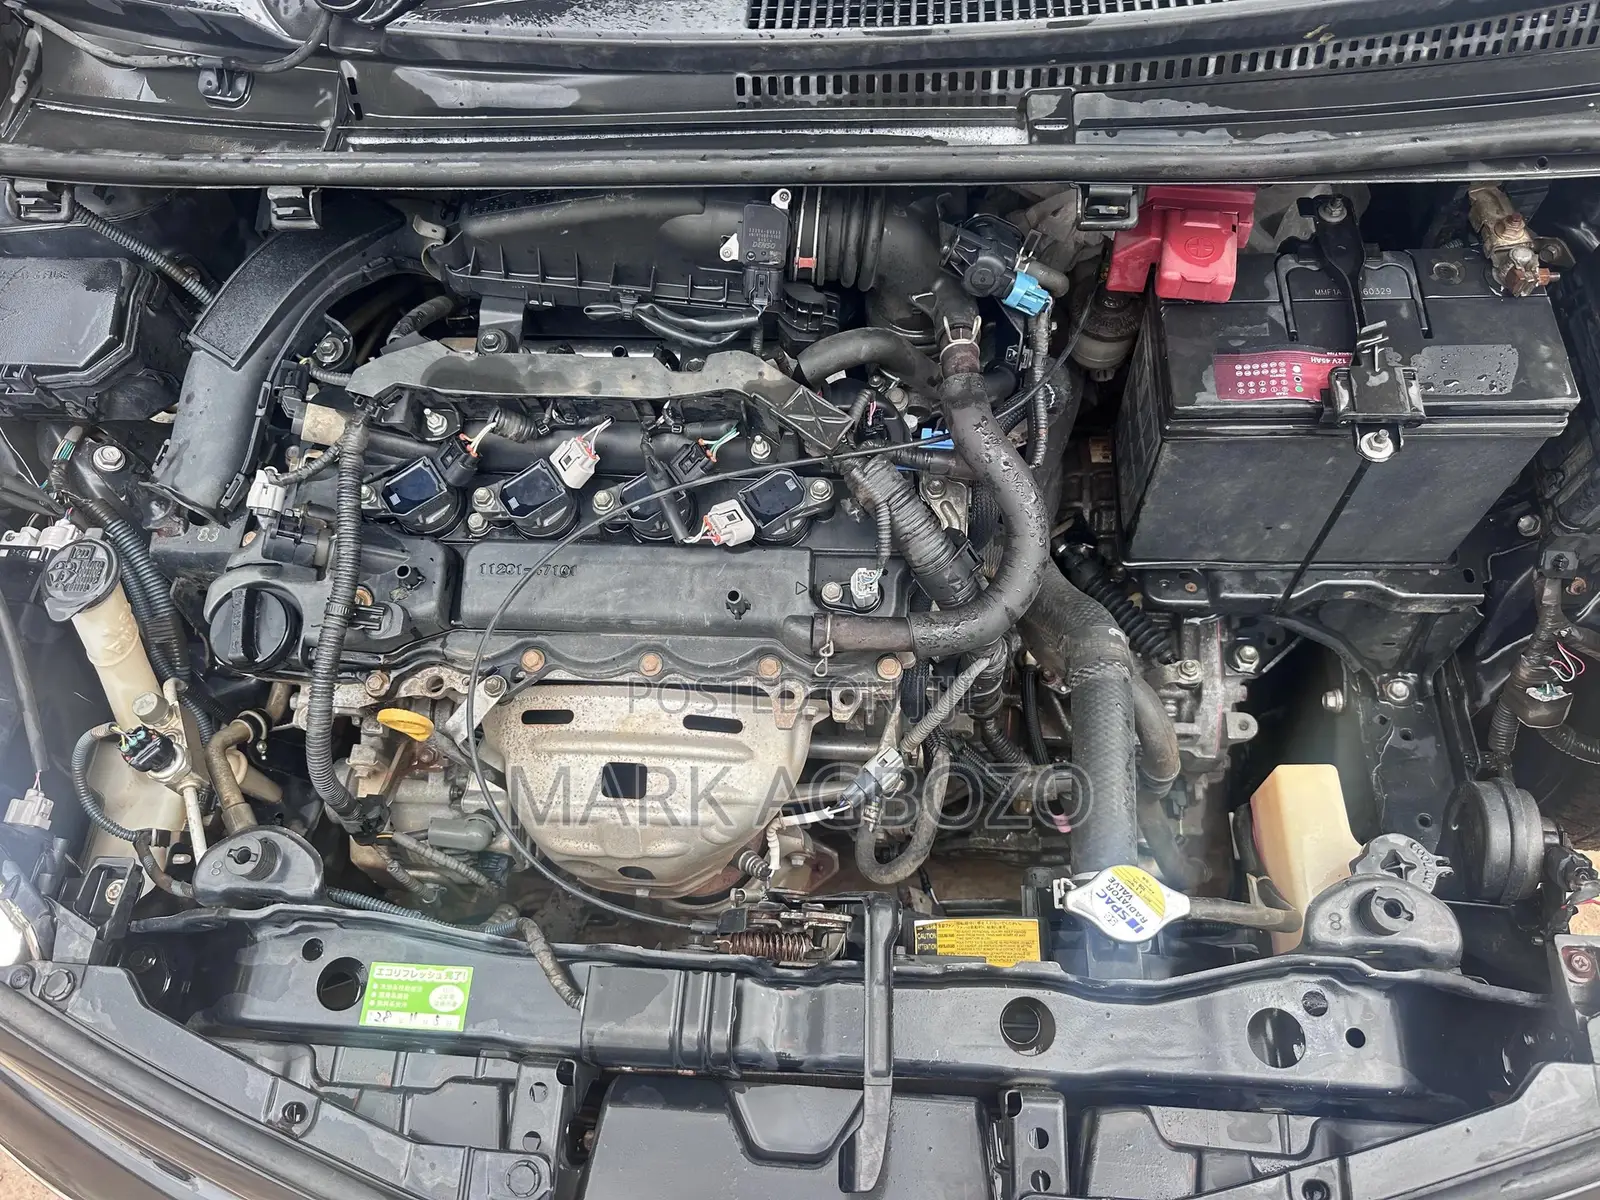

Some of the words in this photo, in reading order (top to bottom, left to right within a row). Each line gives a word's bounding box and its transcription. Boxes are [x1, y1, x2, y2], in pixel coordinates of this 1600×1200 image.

[752, 241, 776, 249] DENSO
[1107, 876, 1134, 901] VALVE
[1095, 888, 1131, 922] SPAC
[1105, 883, 1149, 924] RADIATOR
